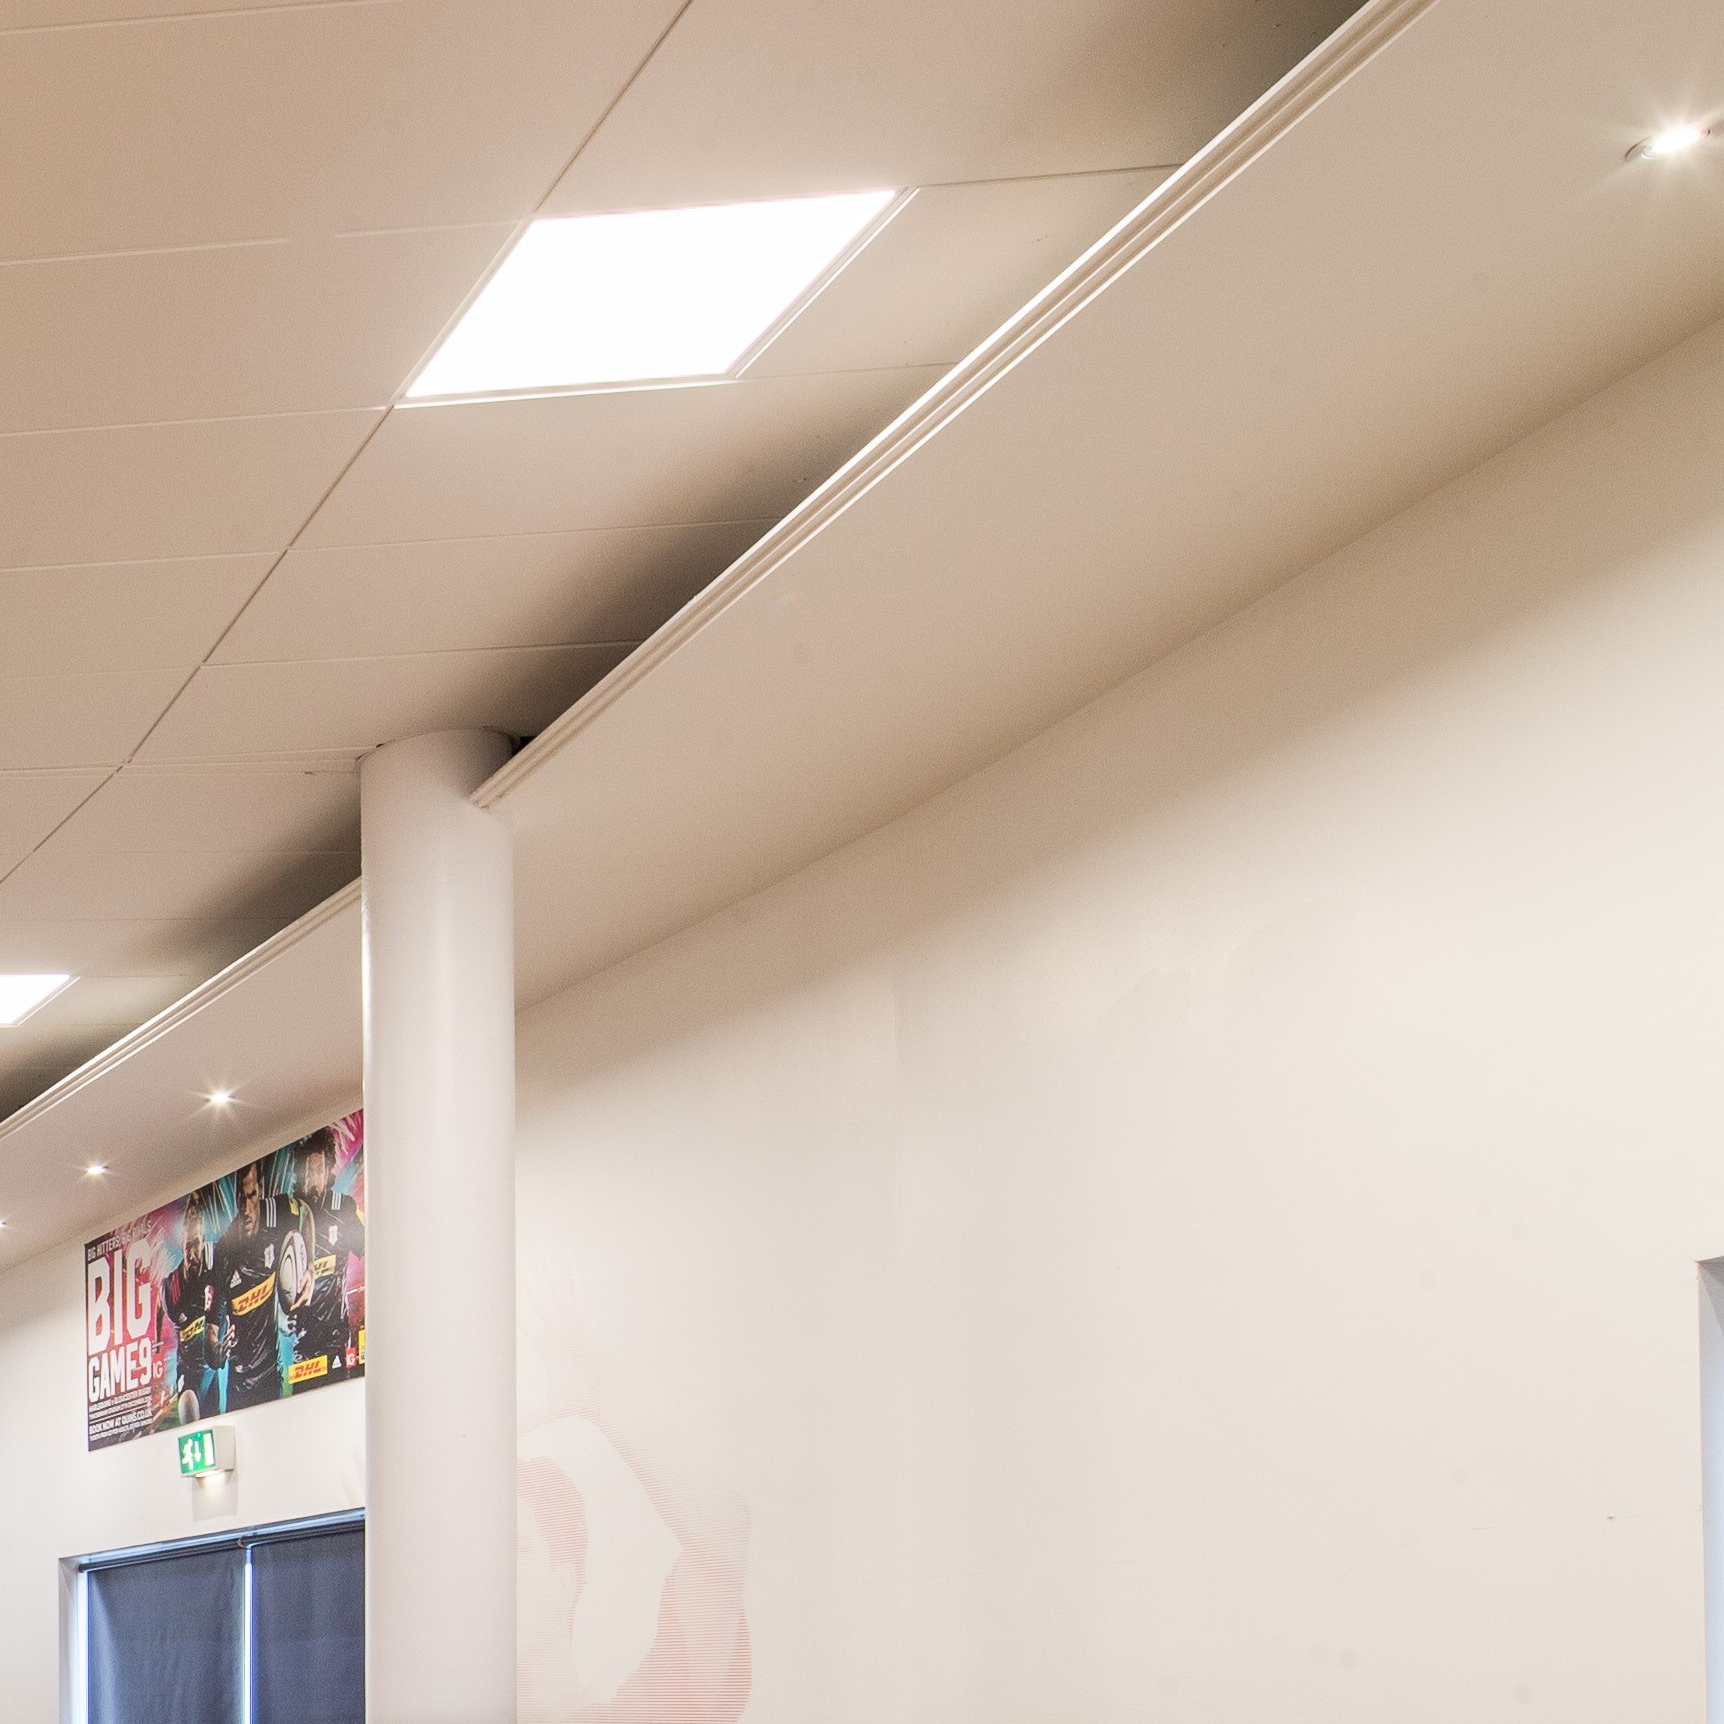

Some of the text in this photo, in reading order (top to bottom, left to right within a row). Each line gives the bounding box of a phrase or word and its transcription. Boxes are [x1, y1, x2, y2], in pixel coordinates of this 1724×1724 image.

[88, 1238, 152, 1356] BIG
[237, 1285, 268, 1312] DHL
[88, 1341, 139, 1403] GAME
[294, 1361, 321, 1378] DHL
